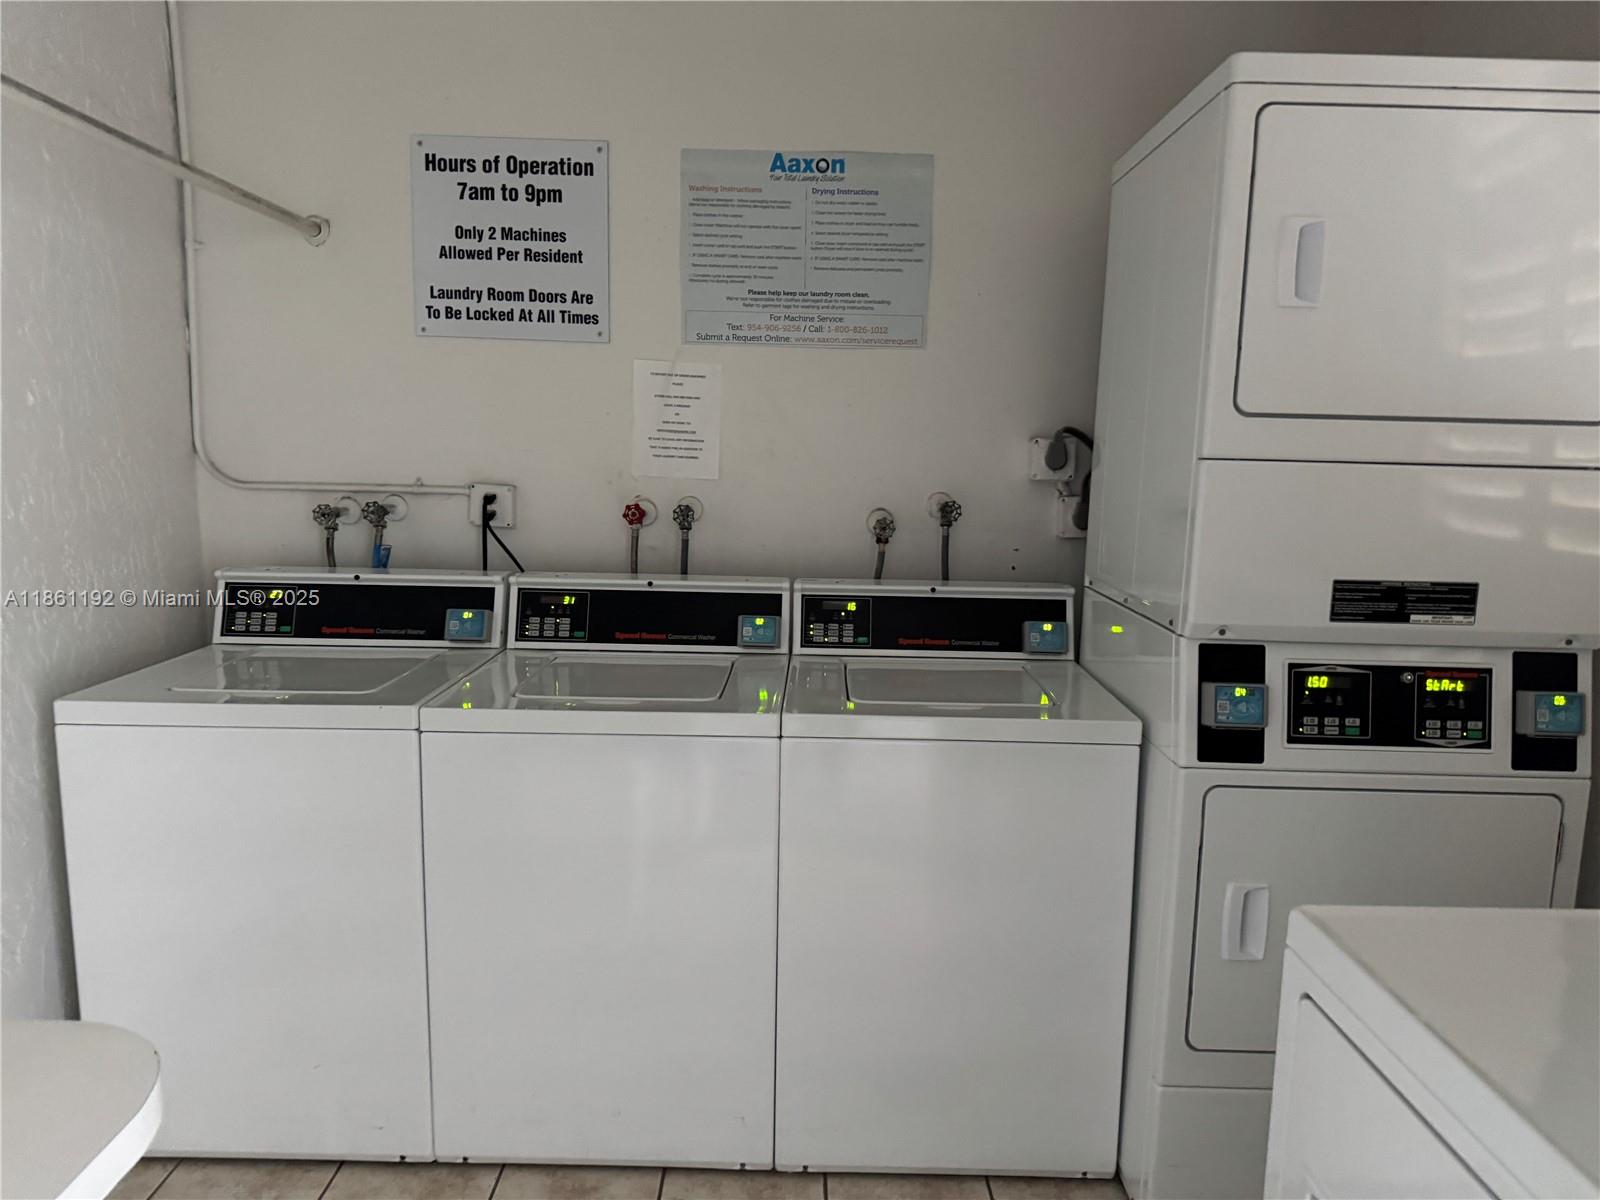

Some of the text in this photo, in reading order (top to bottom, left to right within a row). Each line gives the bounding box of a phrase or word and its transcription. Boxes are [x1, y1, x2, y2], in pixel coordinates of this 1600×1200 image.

[425, 153, 594, 178] Hours of Operation
[769, 152, 846, 174] Aaxon
[457, 182, 563, 207] 7am to 9pm
[688, 185, 762, 193] Washing Instructions
[811, 188, 835, 196] Drying
[455, 225, 567, 243] Only 2 Machines
[439, 245, 583, 264] Allowed Per Resident
[429, 285, 594, 305] Laundry Room Doors Are
[426, 306, 599, 325] To Be Locked At All Times
[696, 333, 723, 341] Submit
[732, 334, 762, 343] Request
[563, 596, 576, 605] 31
